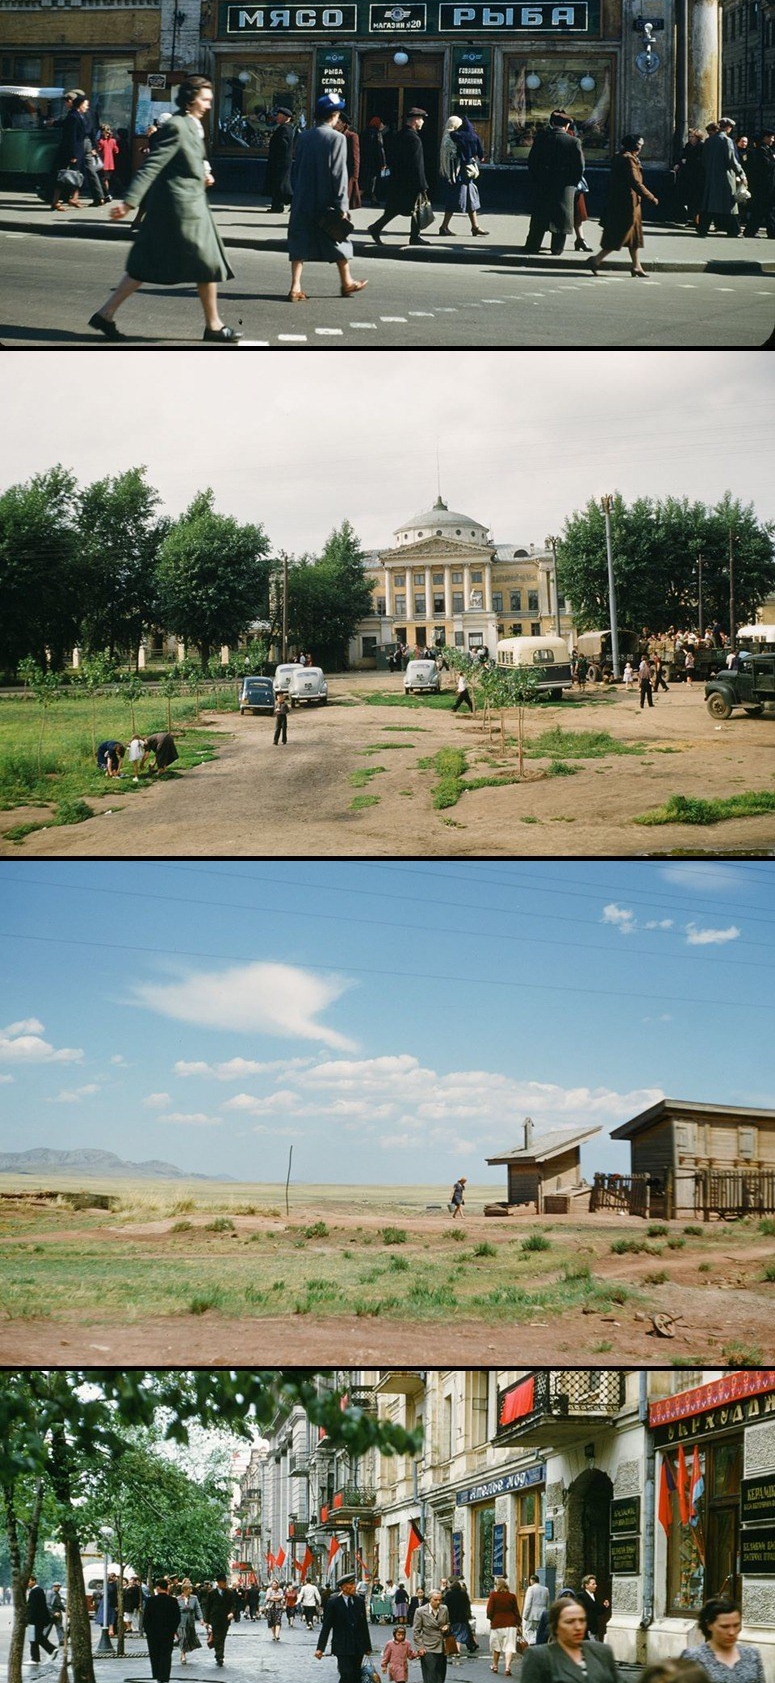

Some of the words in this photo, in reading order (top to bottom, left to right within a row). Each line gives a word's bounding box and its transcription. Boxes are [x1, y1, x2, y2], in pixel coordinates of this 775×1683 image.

[238, 9, 344, 28] МЯСО
[453, 7, 575, 26] РЫБА
[459, 98, 482, 106] ПТИЦА
